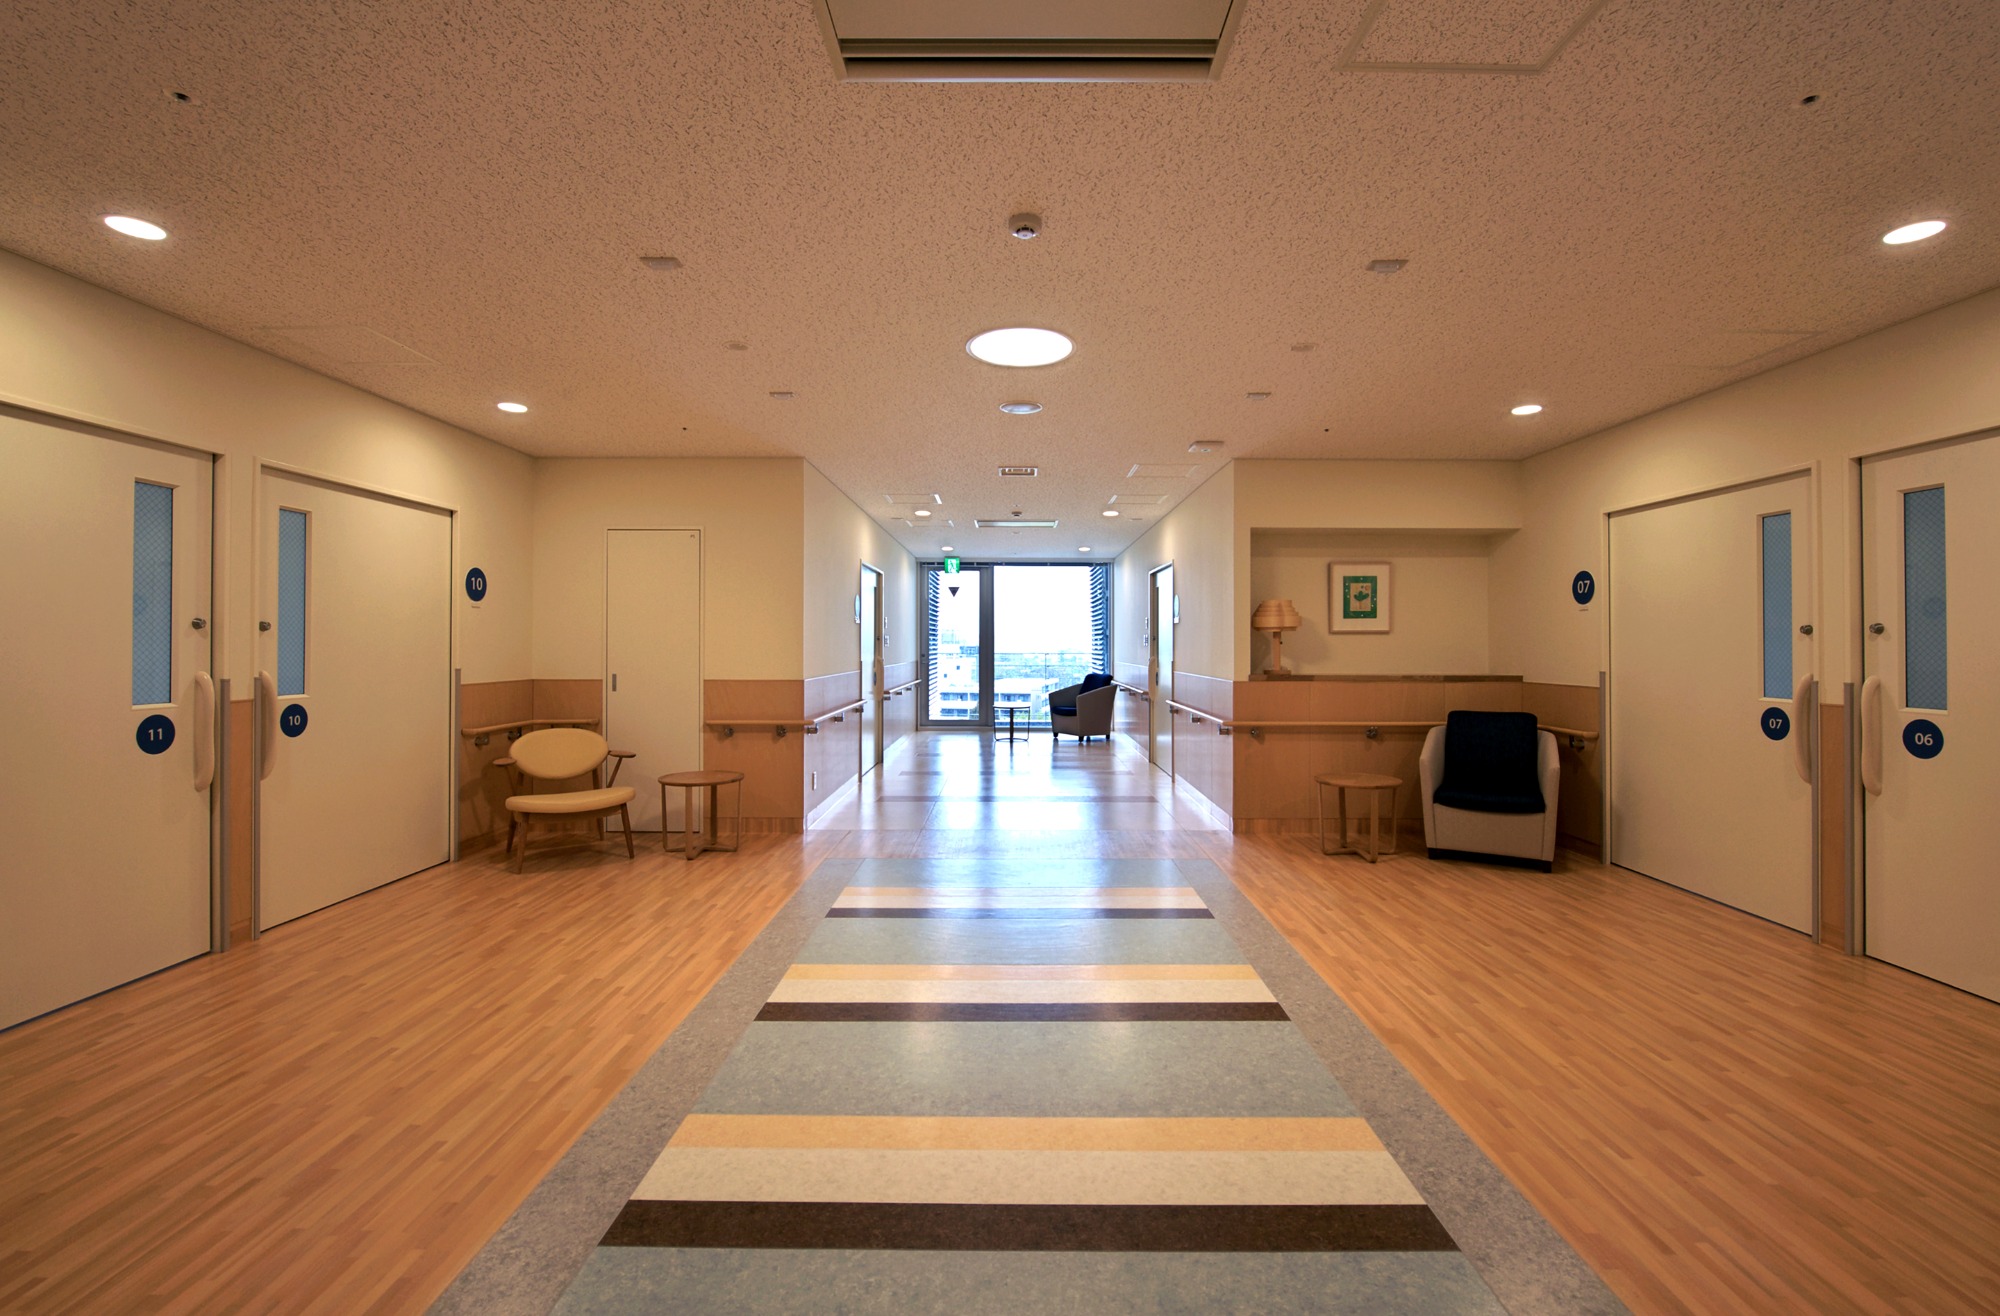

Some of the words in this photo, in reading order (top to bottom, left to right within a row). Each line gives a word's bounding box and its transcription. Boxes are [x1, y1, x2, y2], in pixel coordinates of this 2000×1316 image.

[470, 577, 483, 590] 10
[1577, 580, 1590, 593] 07
[288, 715, 301, 726] 10
[1769, 719, 1783, 729] 07
[148, 728, 162, 740] 11
[1914, 732, 1934, 746] 06
